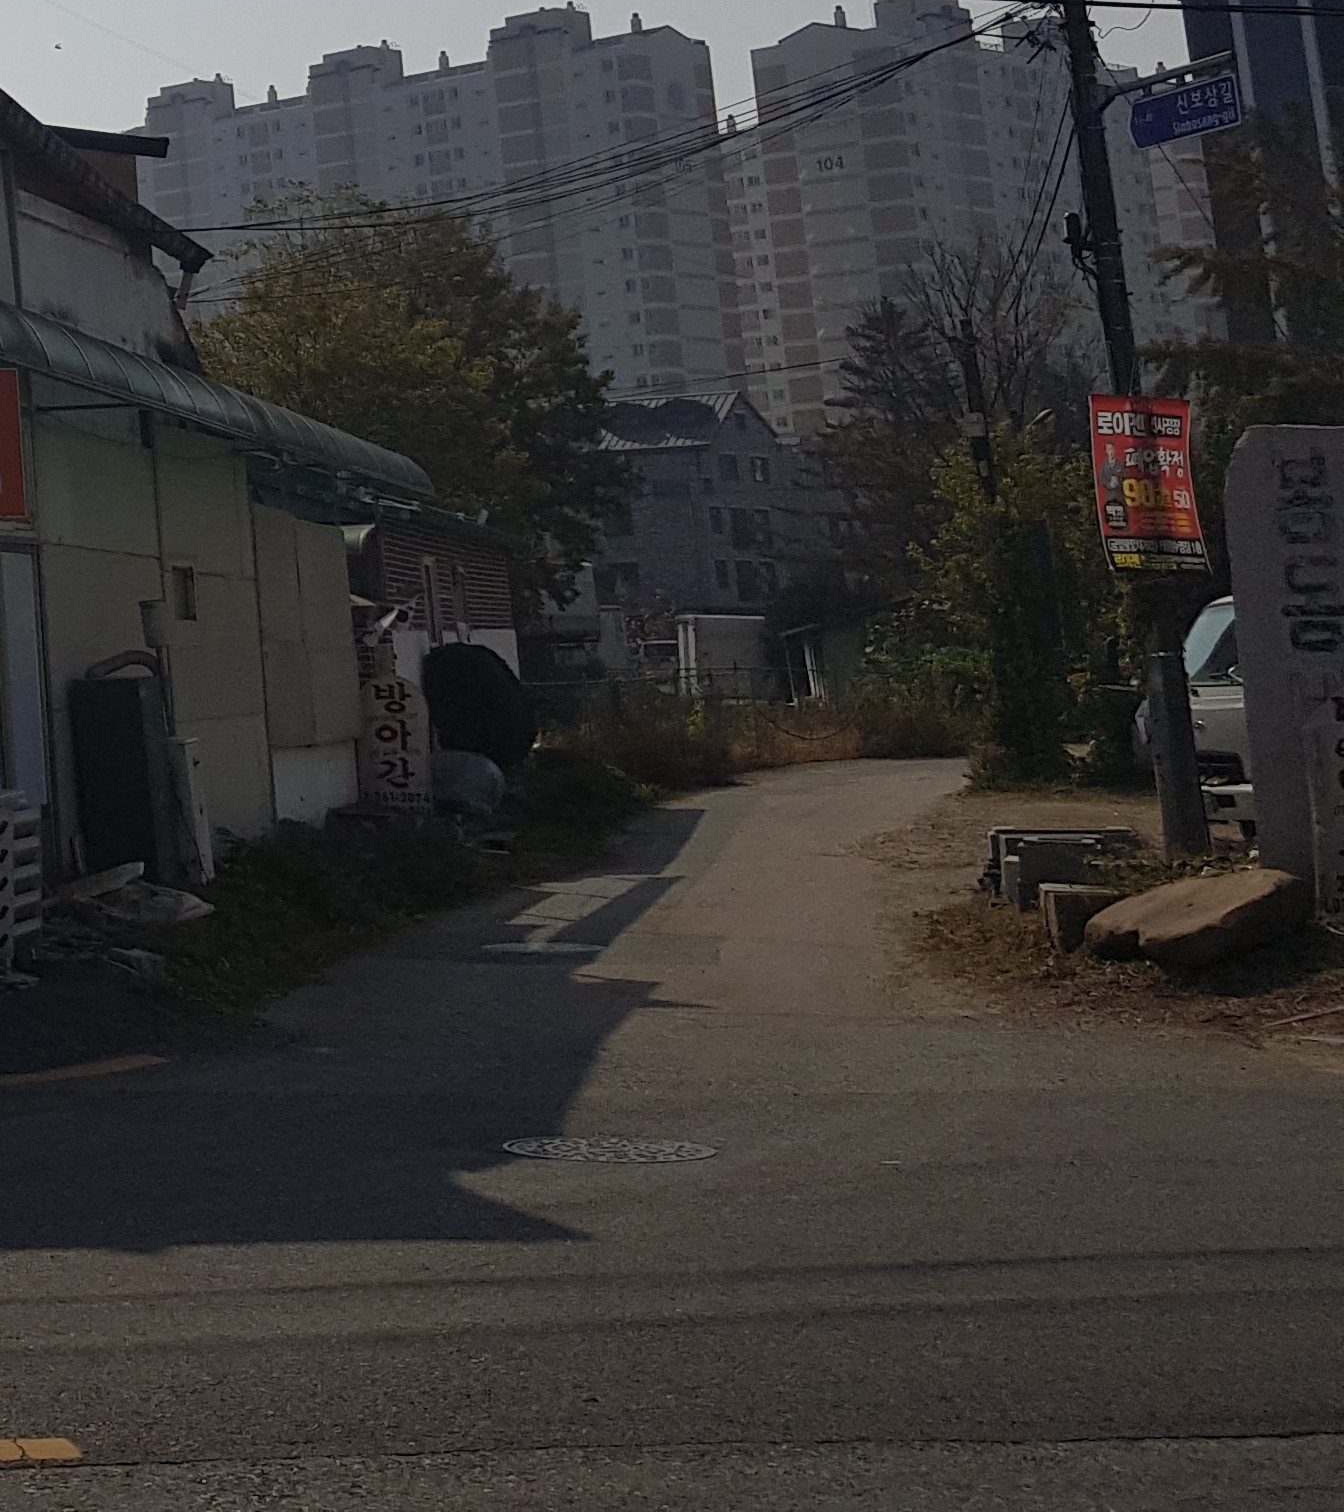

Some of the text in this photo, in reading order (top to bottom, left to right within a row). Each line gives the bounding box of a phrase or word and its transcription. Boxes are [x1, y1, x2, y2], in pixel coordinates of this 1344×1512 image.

[1176, 81, 1234, 115] 신보상길
[815, 155, 845, 173] 104
[372, 681, 415, 788] 방아간
